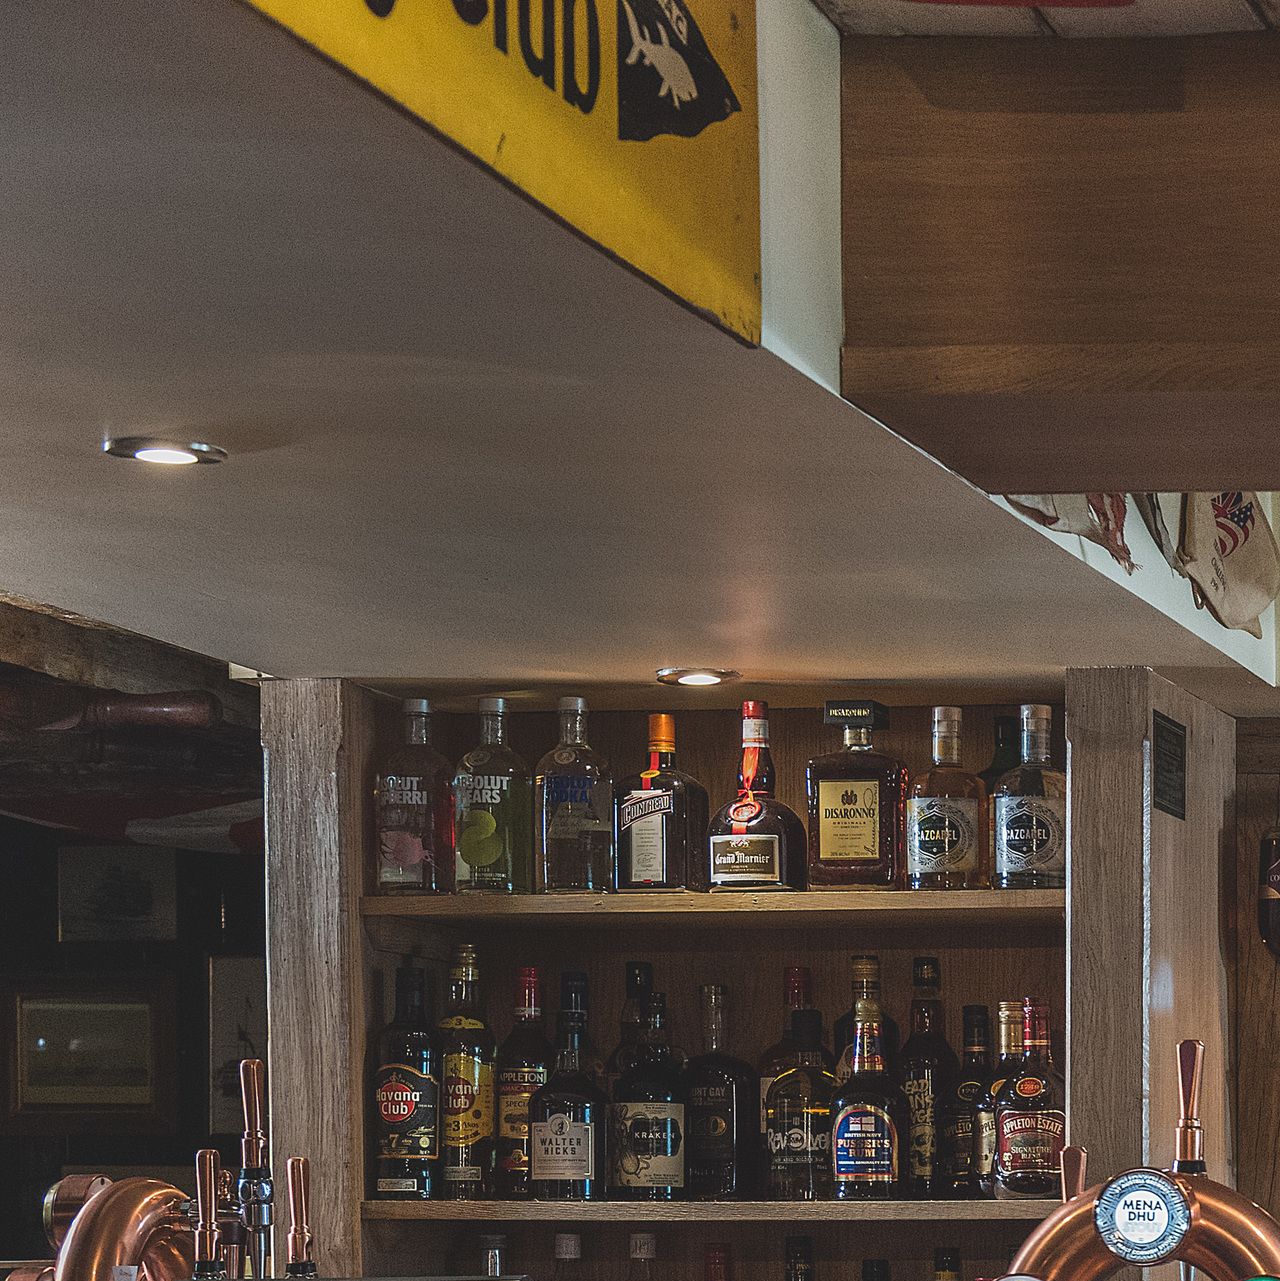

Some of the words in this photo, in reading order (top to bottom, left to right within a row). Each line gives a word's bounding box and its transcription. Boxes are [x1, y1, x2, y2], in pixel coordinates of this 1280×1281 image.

[622, 794, 671, 826] COINTREAU
[824, 808, 875, 819] DISARONNO
[715, 852, 737, 865] Grand
[737, 852, 770, 865] Marnier
[377, 1089, 420, 1102] Havana
[382, 1102, 409, 1115] Club
[1003, 1118, 1036, 1136] APPLETON
[1037, 1117, 1064, 1135] ESTATE
[540, 1138, 582, 1146] WALTER
[837, 1139, 891, 1148] PUSSER'S
[544, 1147, 577, 1155] HICKS
[849, 1149, 876, 1158] RUM
[1123, 1200, 1163, 1211] MENA
[1128, 1212, 1155, 1222] DHU
